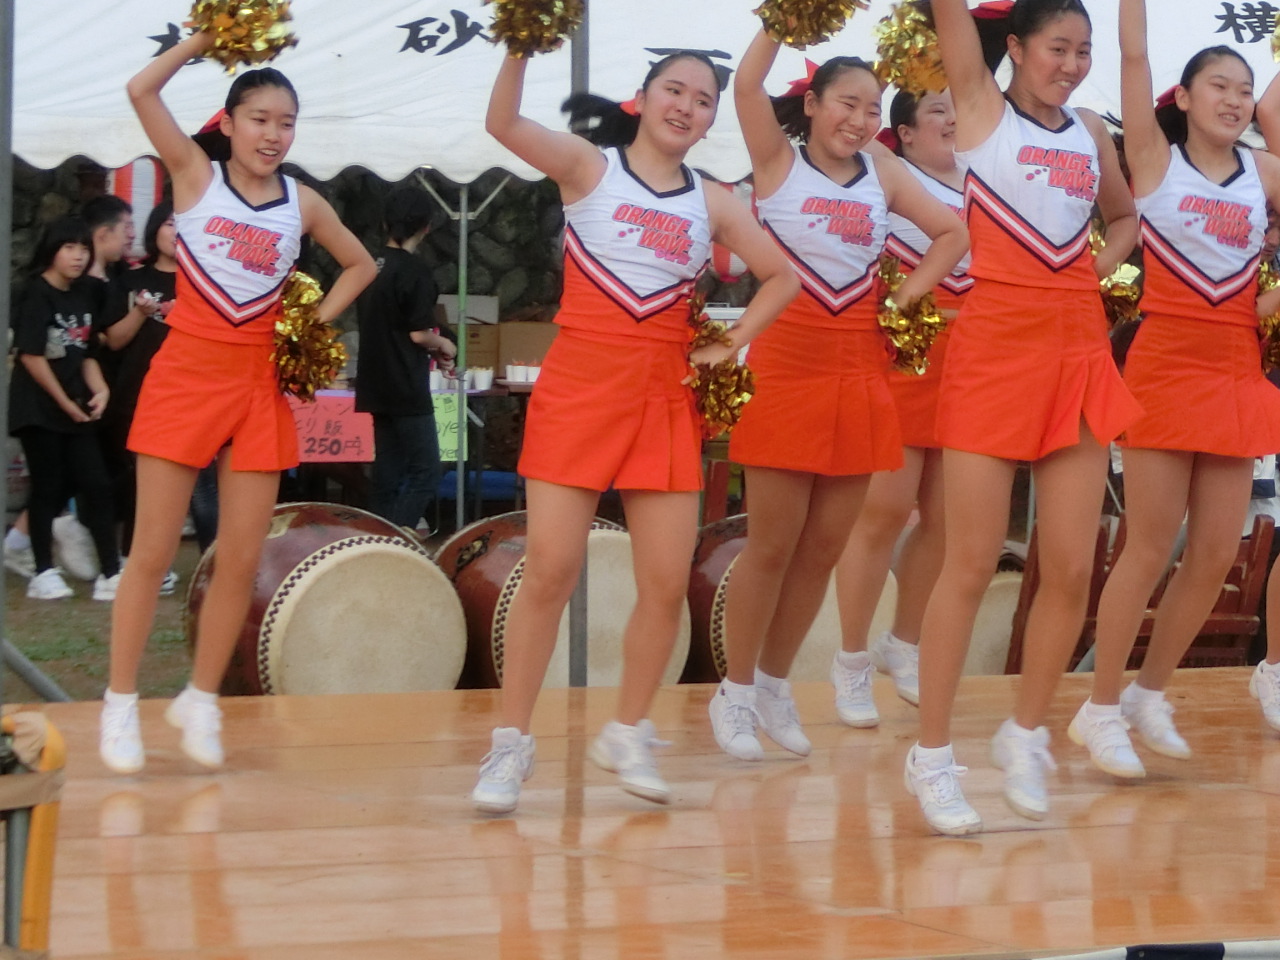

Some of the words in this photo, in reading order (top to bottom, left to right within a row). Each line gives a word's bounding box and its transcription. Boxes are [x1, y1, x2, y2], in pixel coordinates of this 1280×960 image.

[1017, 145, 1093, 174] ORANGE
[1048, 167, 1098, 193] WAVE
[612, 203, 694, 237] ORANGE
[800, 196, 873, 221] ORANGE
[1177, 194, 1254, 221] ORANGE
[203, 215, 284, 250] ORANGE
[825, 216, 876, 238] WAVE
[1202, 215, 1254, 240] WAVE
[226, 240, 282, 268] WAVE
[637, 227, 695, 256] WAVE
[304, 435, 365, 458] 250円
